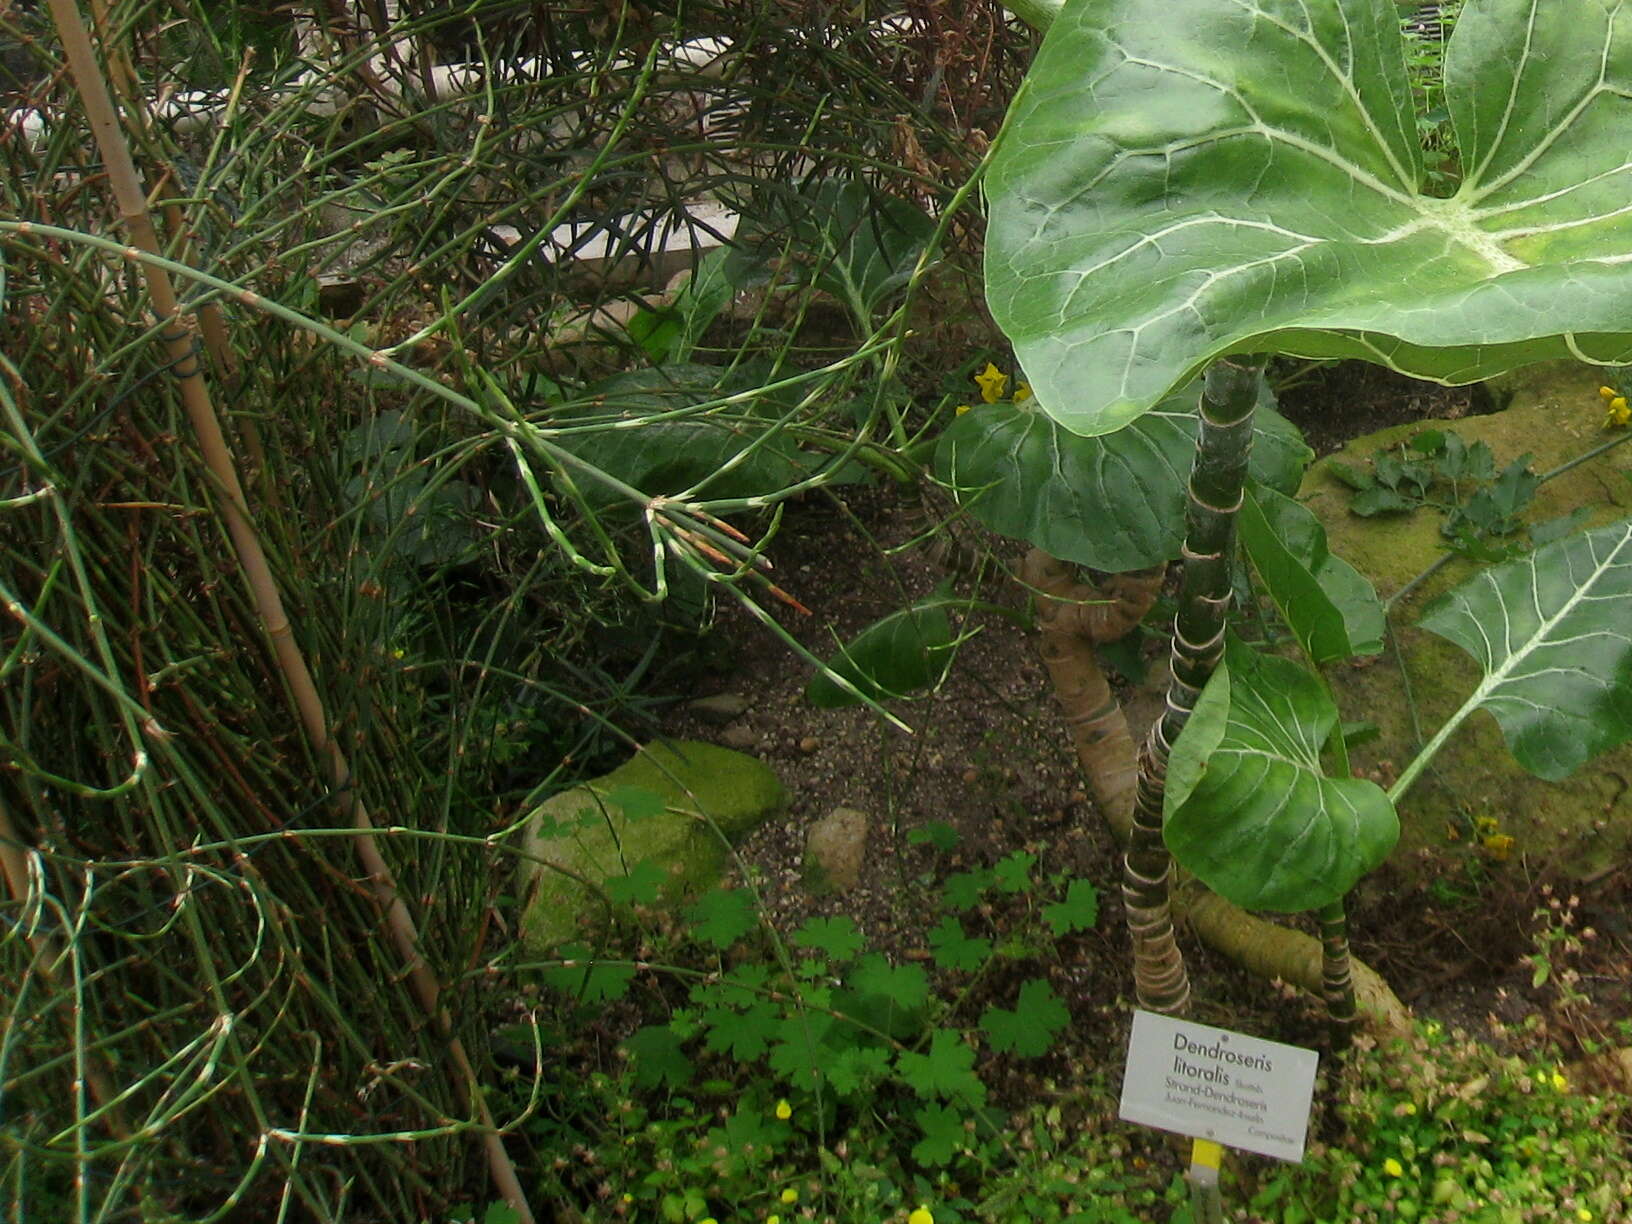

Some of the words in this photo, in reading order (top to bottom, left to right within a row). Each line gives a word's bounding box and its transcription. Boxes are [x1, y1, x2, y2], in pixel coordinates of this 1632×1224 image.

[1174, 1032, 1273, 1073] Dendroseris
[1174, 1055, 1230, 1086] litoralis
[1165, 1076, 1268, 1112] Strand-Dendroseris
